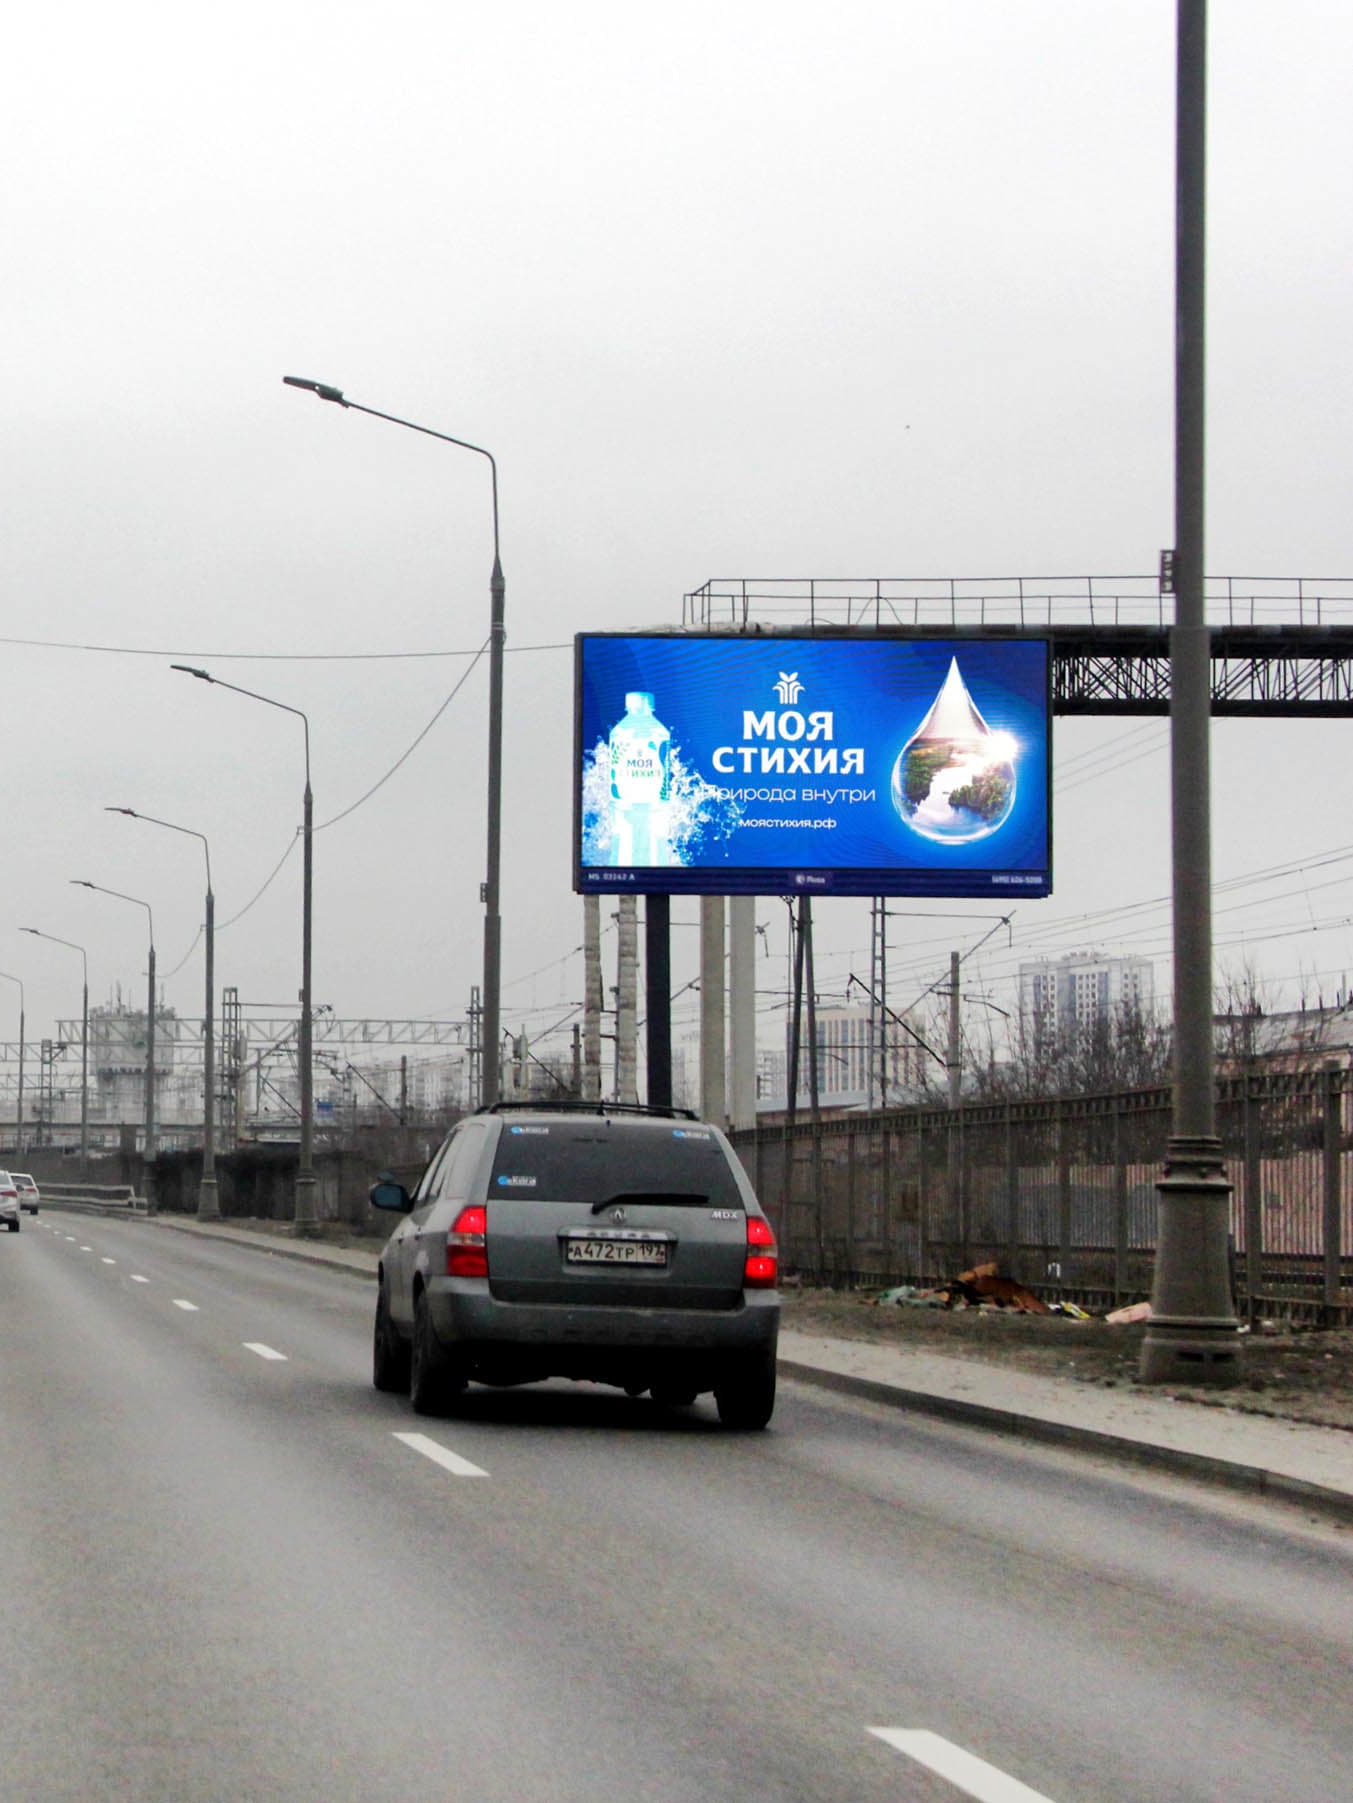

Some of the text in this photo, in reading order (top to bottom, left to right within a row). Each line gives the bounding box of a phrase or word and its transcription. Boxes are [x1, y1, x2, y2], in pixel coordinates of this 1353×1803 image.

[743, 710, 834, 741] МОЯ
[626, 759, 653, 769] МОЯ
[712, 746, 865, 775] СТИХИЯ
[704, 787, 877, 804] рирода внутри
[739, 817, 838, 830] моястихия.рф
[711, 1210, 738, 1219] MDX
